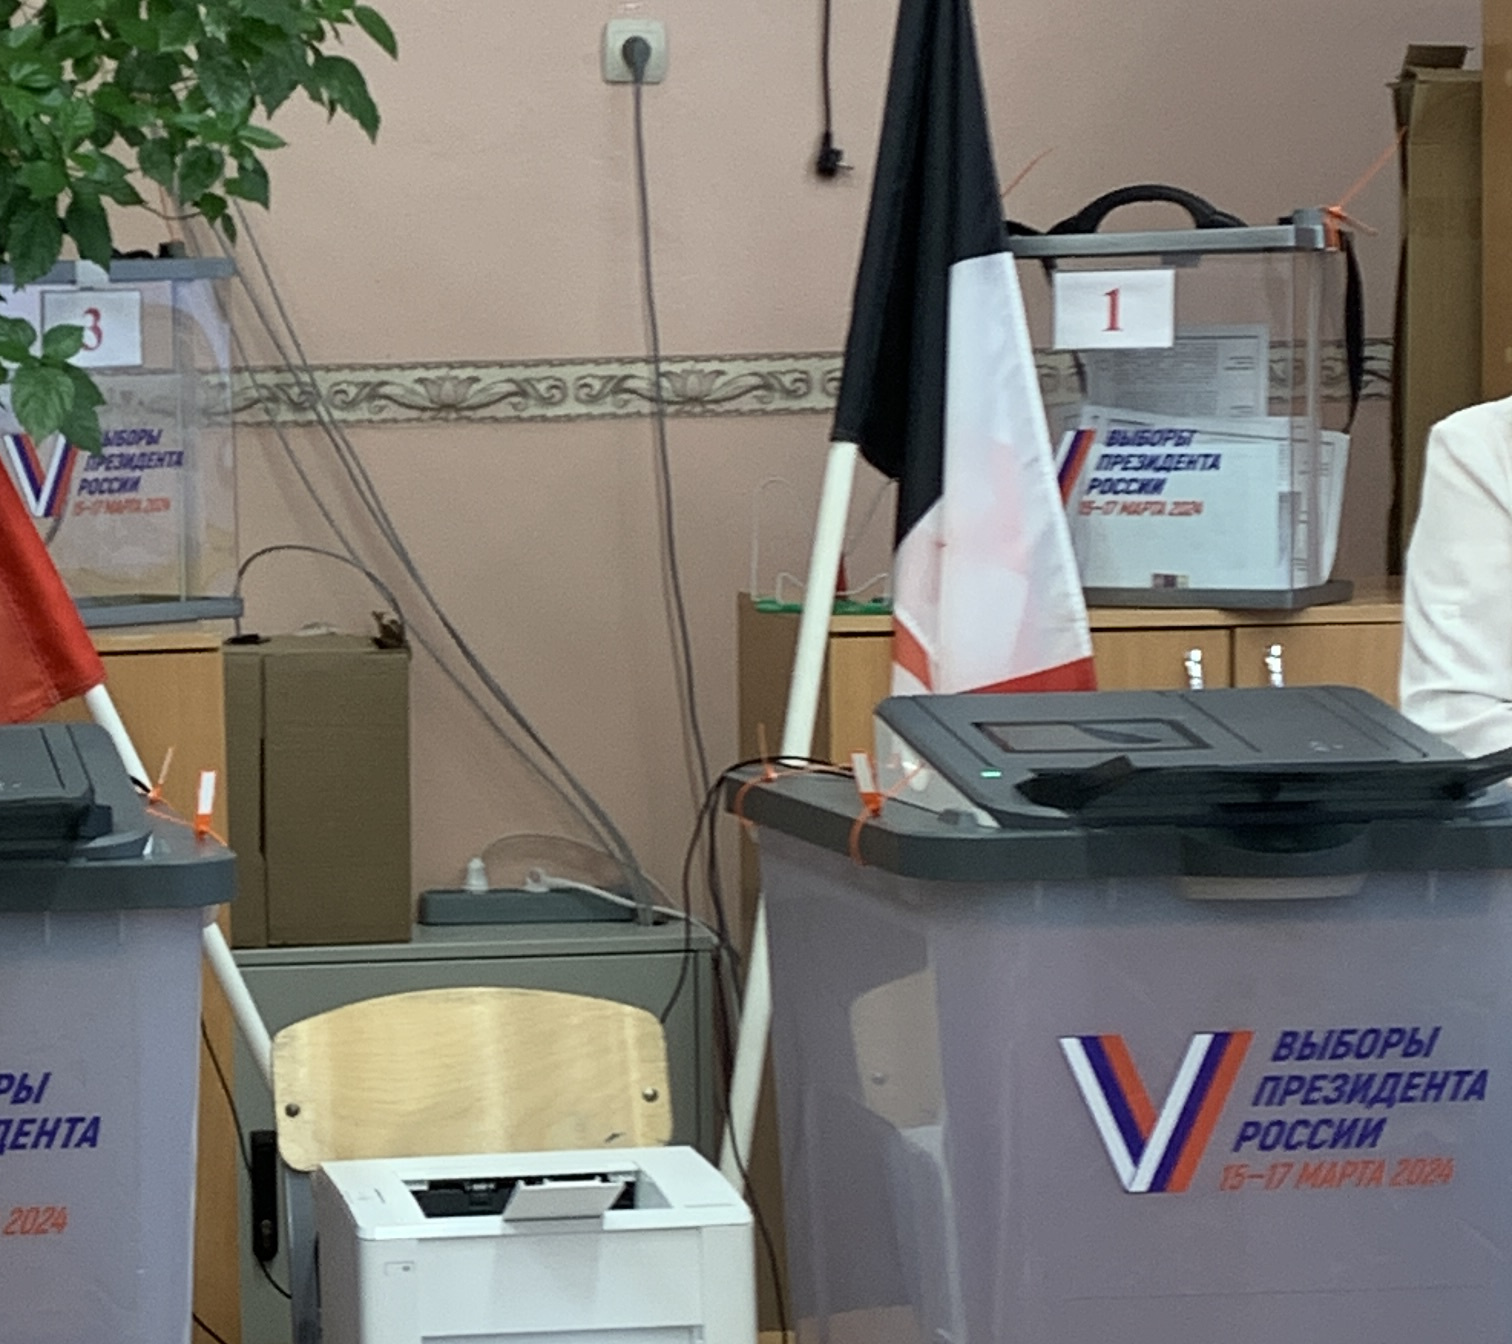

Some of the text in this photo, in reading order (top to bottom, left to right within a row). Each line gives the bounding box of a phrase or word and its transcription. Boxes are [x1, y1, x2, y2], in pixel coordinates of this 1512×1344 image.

[1100, 287, 1123, 332] 1
[81, 307, 103, 351] 3
[102, 428, 163, 447] ЫБОРЫ
[1105, 427, 1198, 447] ВЫБОРЫ
[84, 450, 185, 471] ПРЕЗИДЕНТА
[1095, 453, 1223, 473] ПРЕЗИДЕНТА
[77, 476, 142, 496] РОССИИ
[1085, 477, 1168, 496] РОССИИ
[1119, 500, 1167, 516] МАРТА
[1270, 1025, 1442, 1062] ВЫБОРЫ
[1251, 1068, 1490, 1109] ПРЕЗИДЕНТА
[1232, 1117, 1388, 1154] РОССИИ
[1292, 1159, 1386, 1190] МАРТА
[1387, 1157, 1455, 1188] 2024
[2, 1206, 70, 1237] 2024
